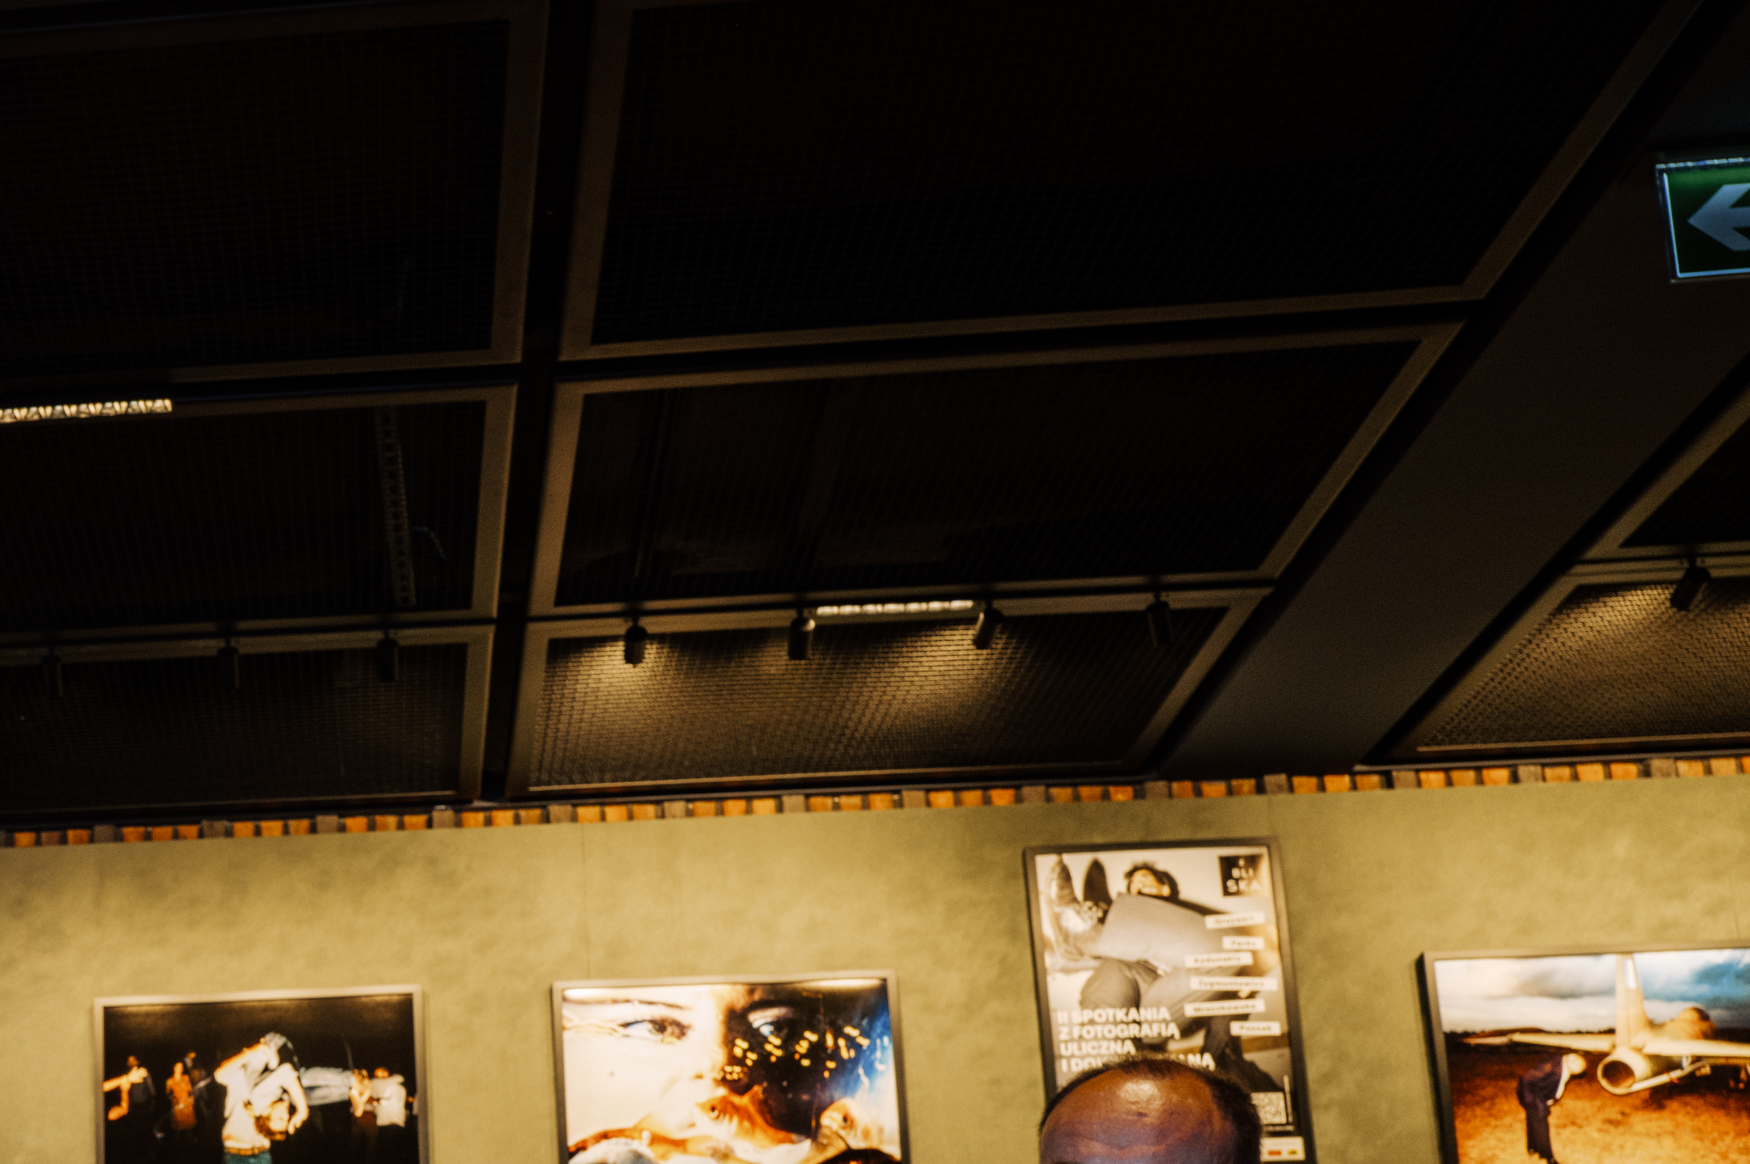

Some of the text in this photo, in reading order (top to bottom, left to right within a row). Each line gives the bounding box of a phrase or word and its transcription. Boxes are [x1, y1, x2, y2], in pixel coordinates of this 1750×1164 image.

[1231, 867, 1254, 879] BLI
[1226, 878, 1261, 893] SKA
[1056, 1006, 1172, 1025] II SPOTKANIA
[1058, 1022, 1182, 1041] Z FOTOGRAFIĄ
